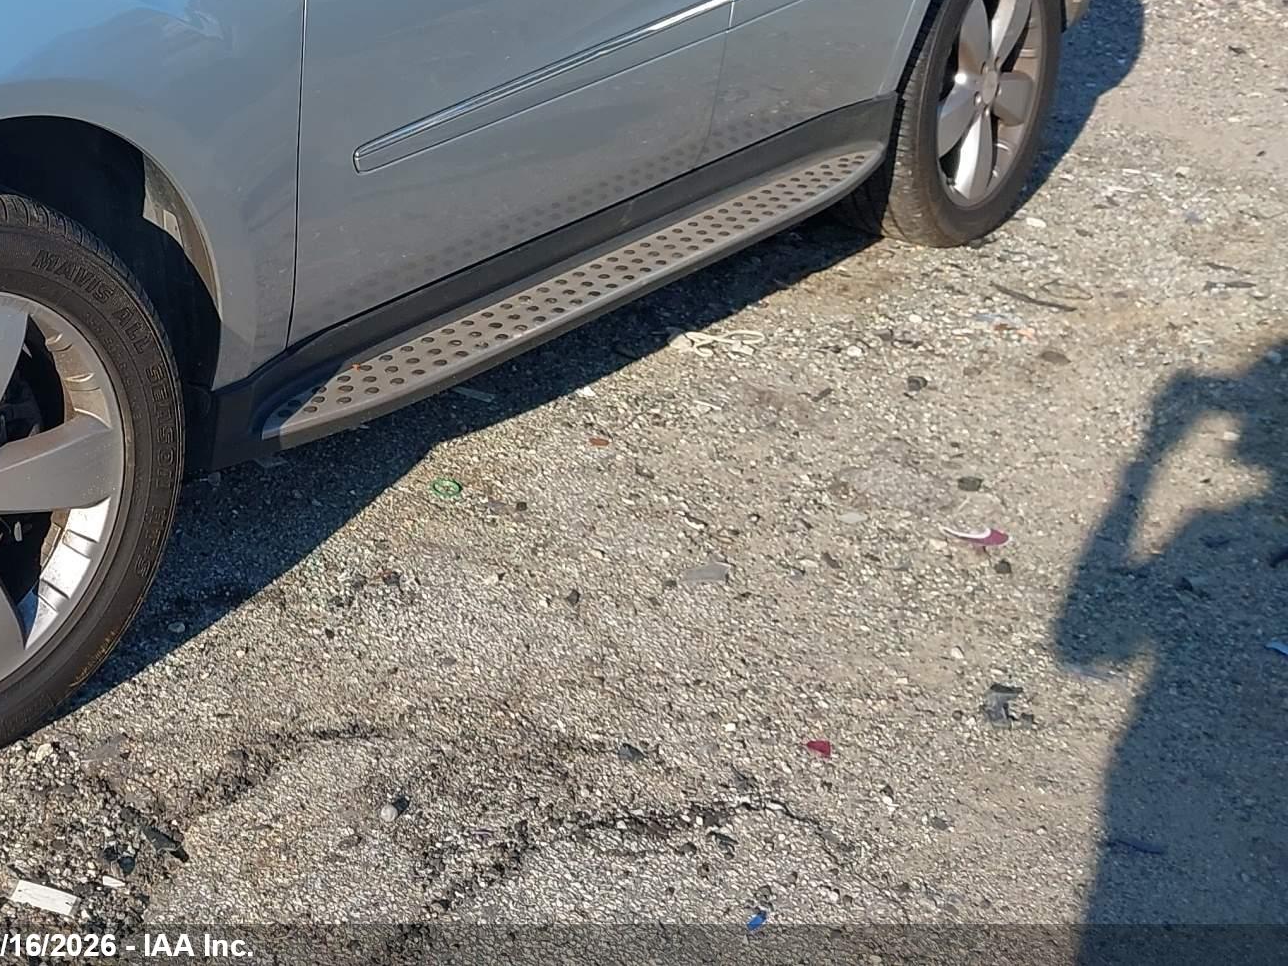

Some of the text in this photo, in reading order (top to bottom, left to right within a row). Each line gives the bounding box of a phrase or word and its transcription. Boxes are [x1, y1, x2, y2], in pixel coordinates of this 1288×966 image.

[32, 250, 114, 304] MAVIS
[111, 306, 153, 355] ALL
[144, 362, 176, 489] SEASON
